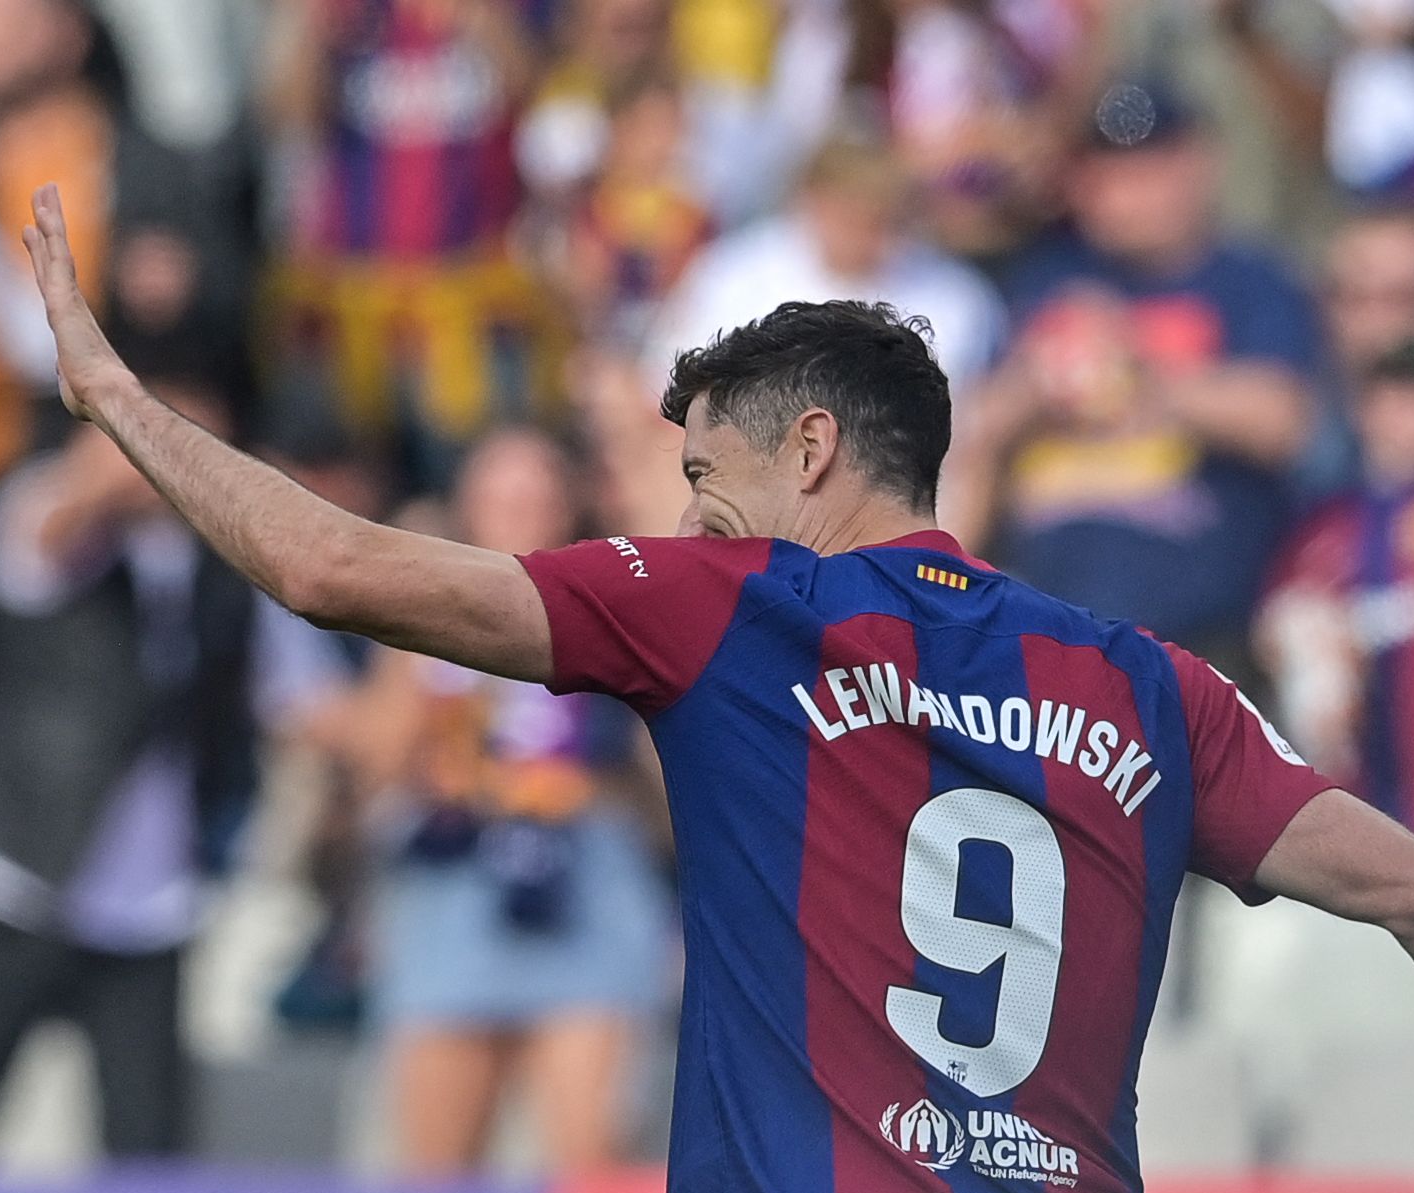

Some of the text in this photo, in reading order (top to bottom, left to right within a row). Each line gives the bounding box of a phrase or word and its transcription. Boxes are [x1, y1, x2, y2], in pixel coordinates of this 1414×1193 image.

[629, 559, 649, 577] tv
[791, 662, 1162, 818] LEWANDOWSKI
[885, 788, 1065, 1097] 9
[967, 1110, 1054, 1143] UNH
[969, 1139, 1079, 1174] ACNUR
[990, 1168, 1007, 1179] UN
[1008, 1169, 1048, 1183] Refugee
[1048, 1173, 1078, 1188] Agency
